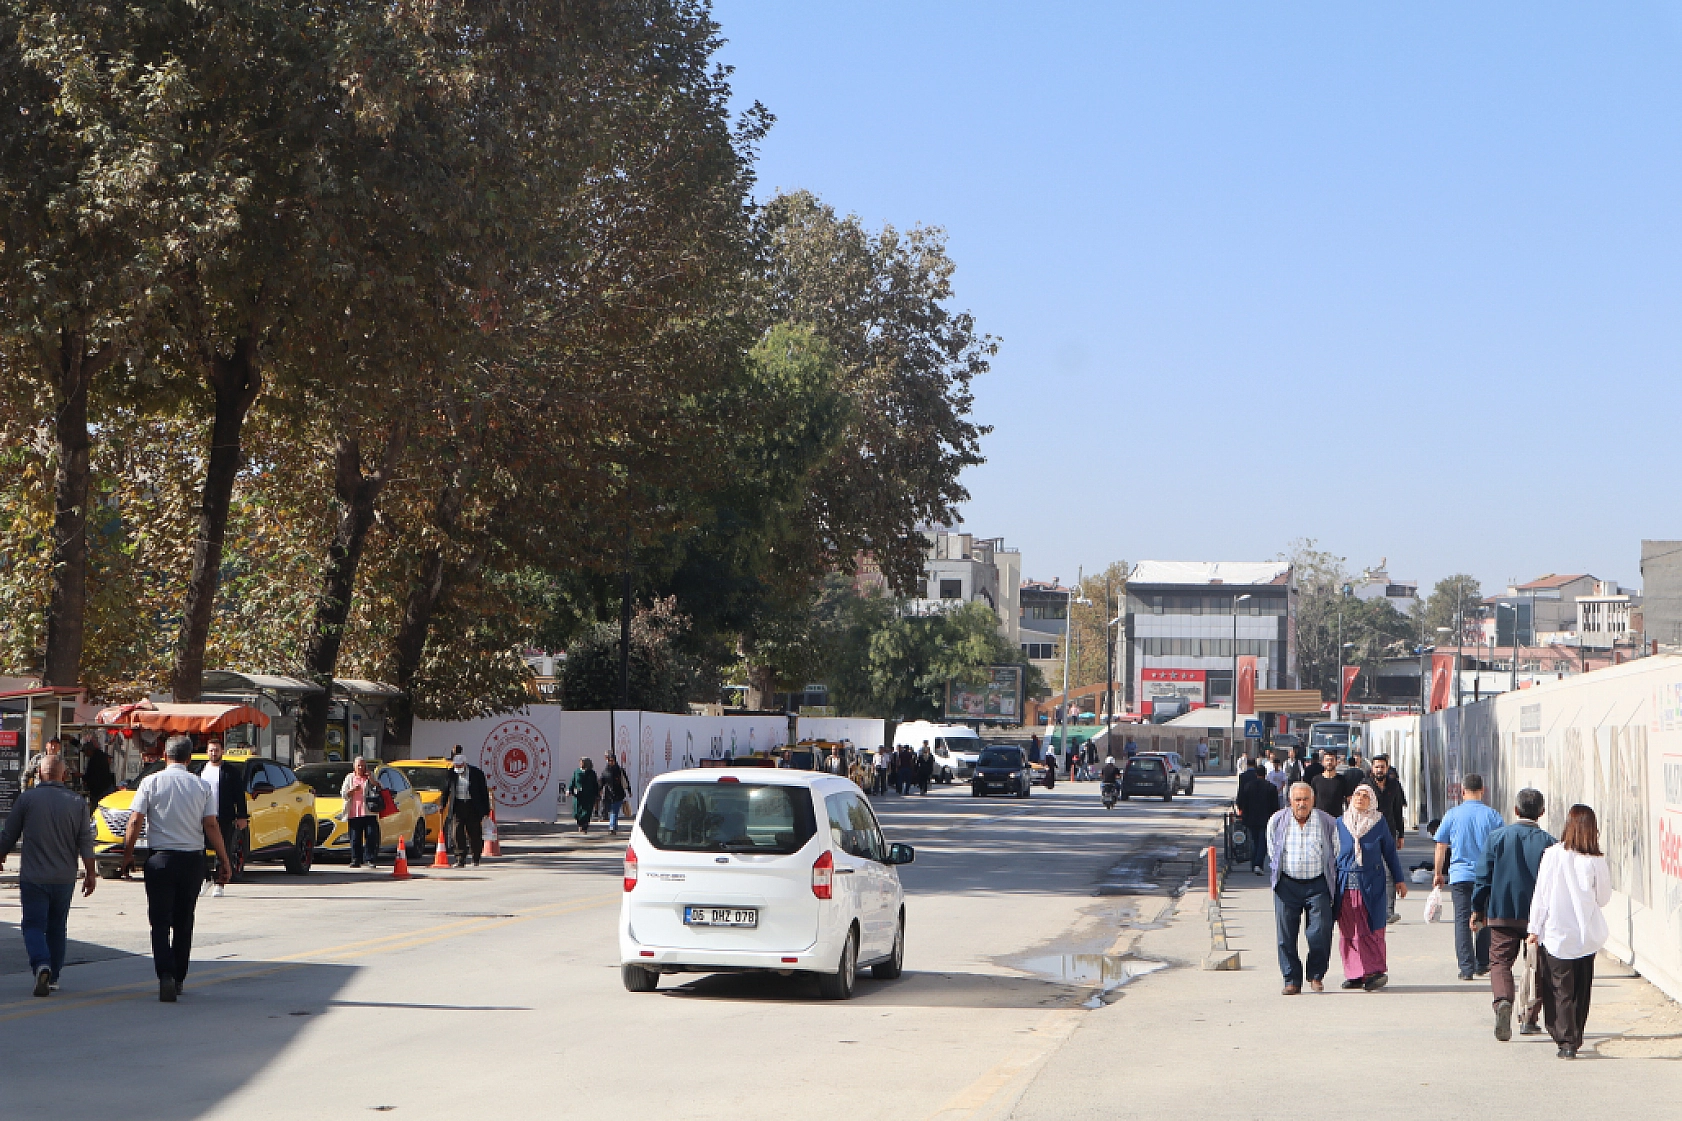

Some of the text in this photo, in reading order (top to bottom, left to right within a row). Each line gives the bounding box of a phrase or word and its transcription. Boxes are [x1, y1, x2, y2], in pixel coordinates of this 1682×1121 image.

[692, 908, 755, 923] 06 DHZ 078
